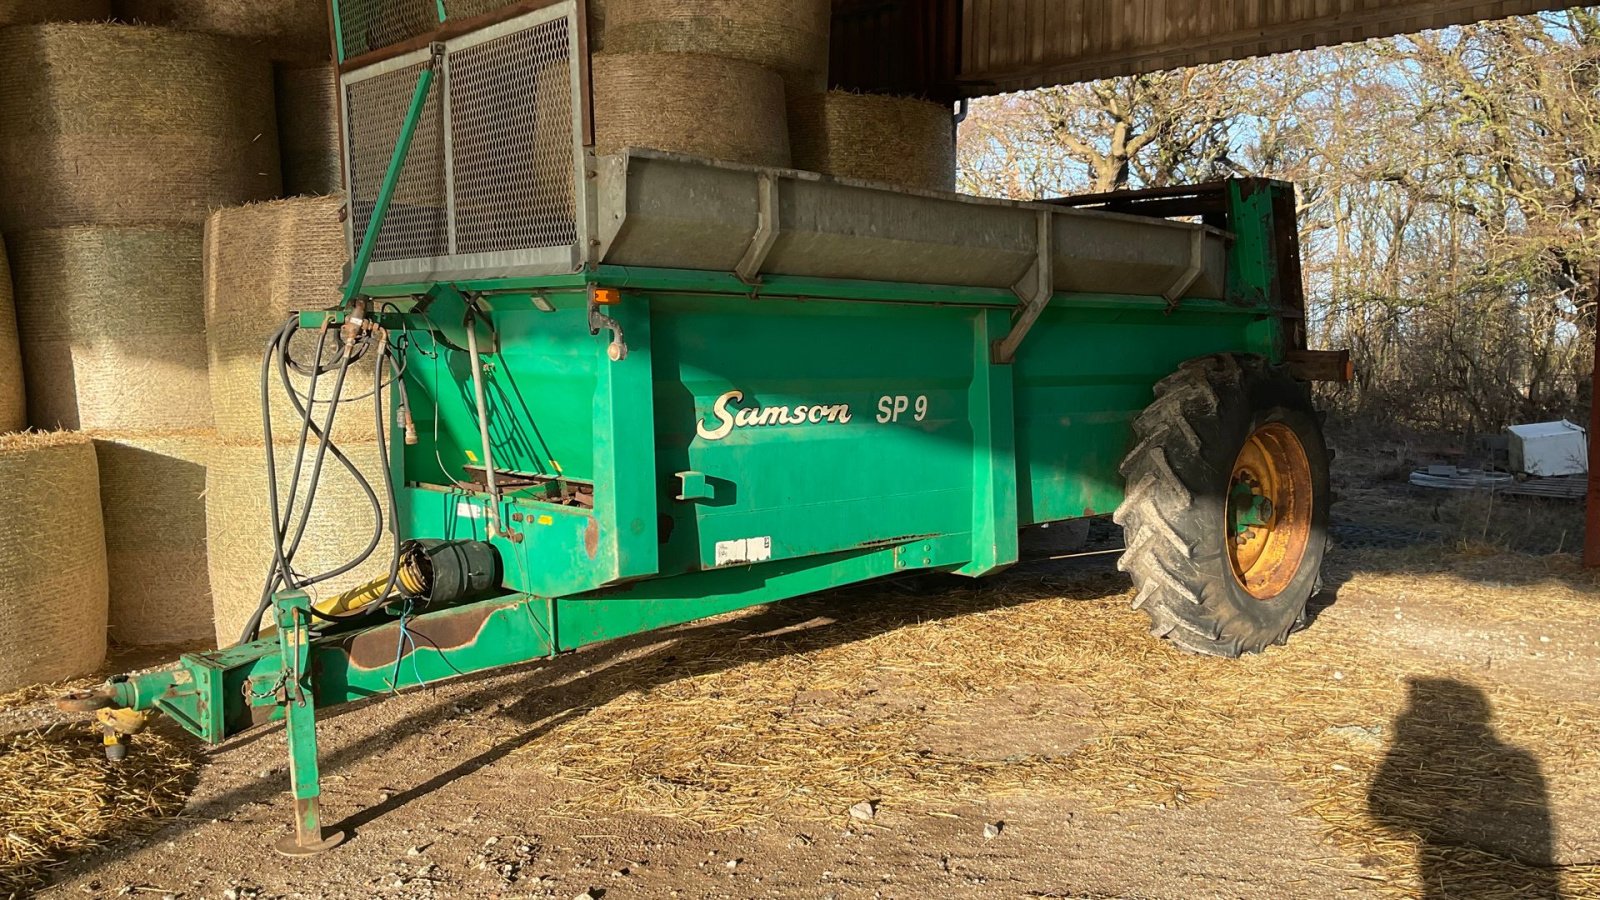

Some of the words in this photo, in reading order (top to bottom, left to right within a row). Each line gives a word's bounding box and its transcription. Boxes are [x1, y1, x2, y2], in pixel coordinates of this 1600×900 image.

[696, 390, 852, 440] Samson
[876, 395, 909, 423] SP
[914, 395, 928, 422] 9
